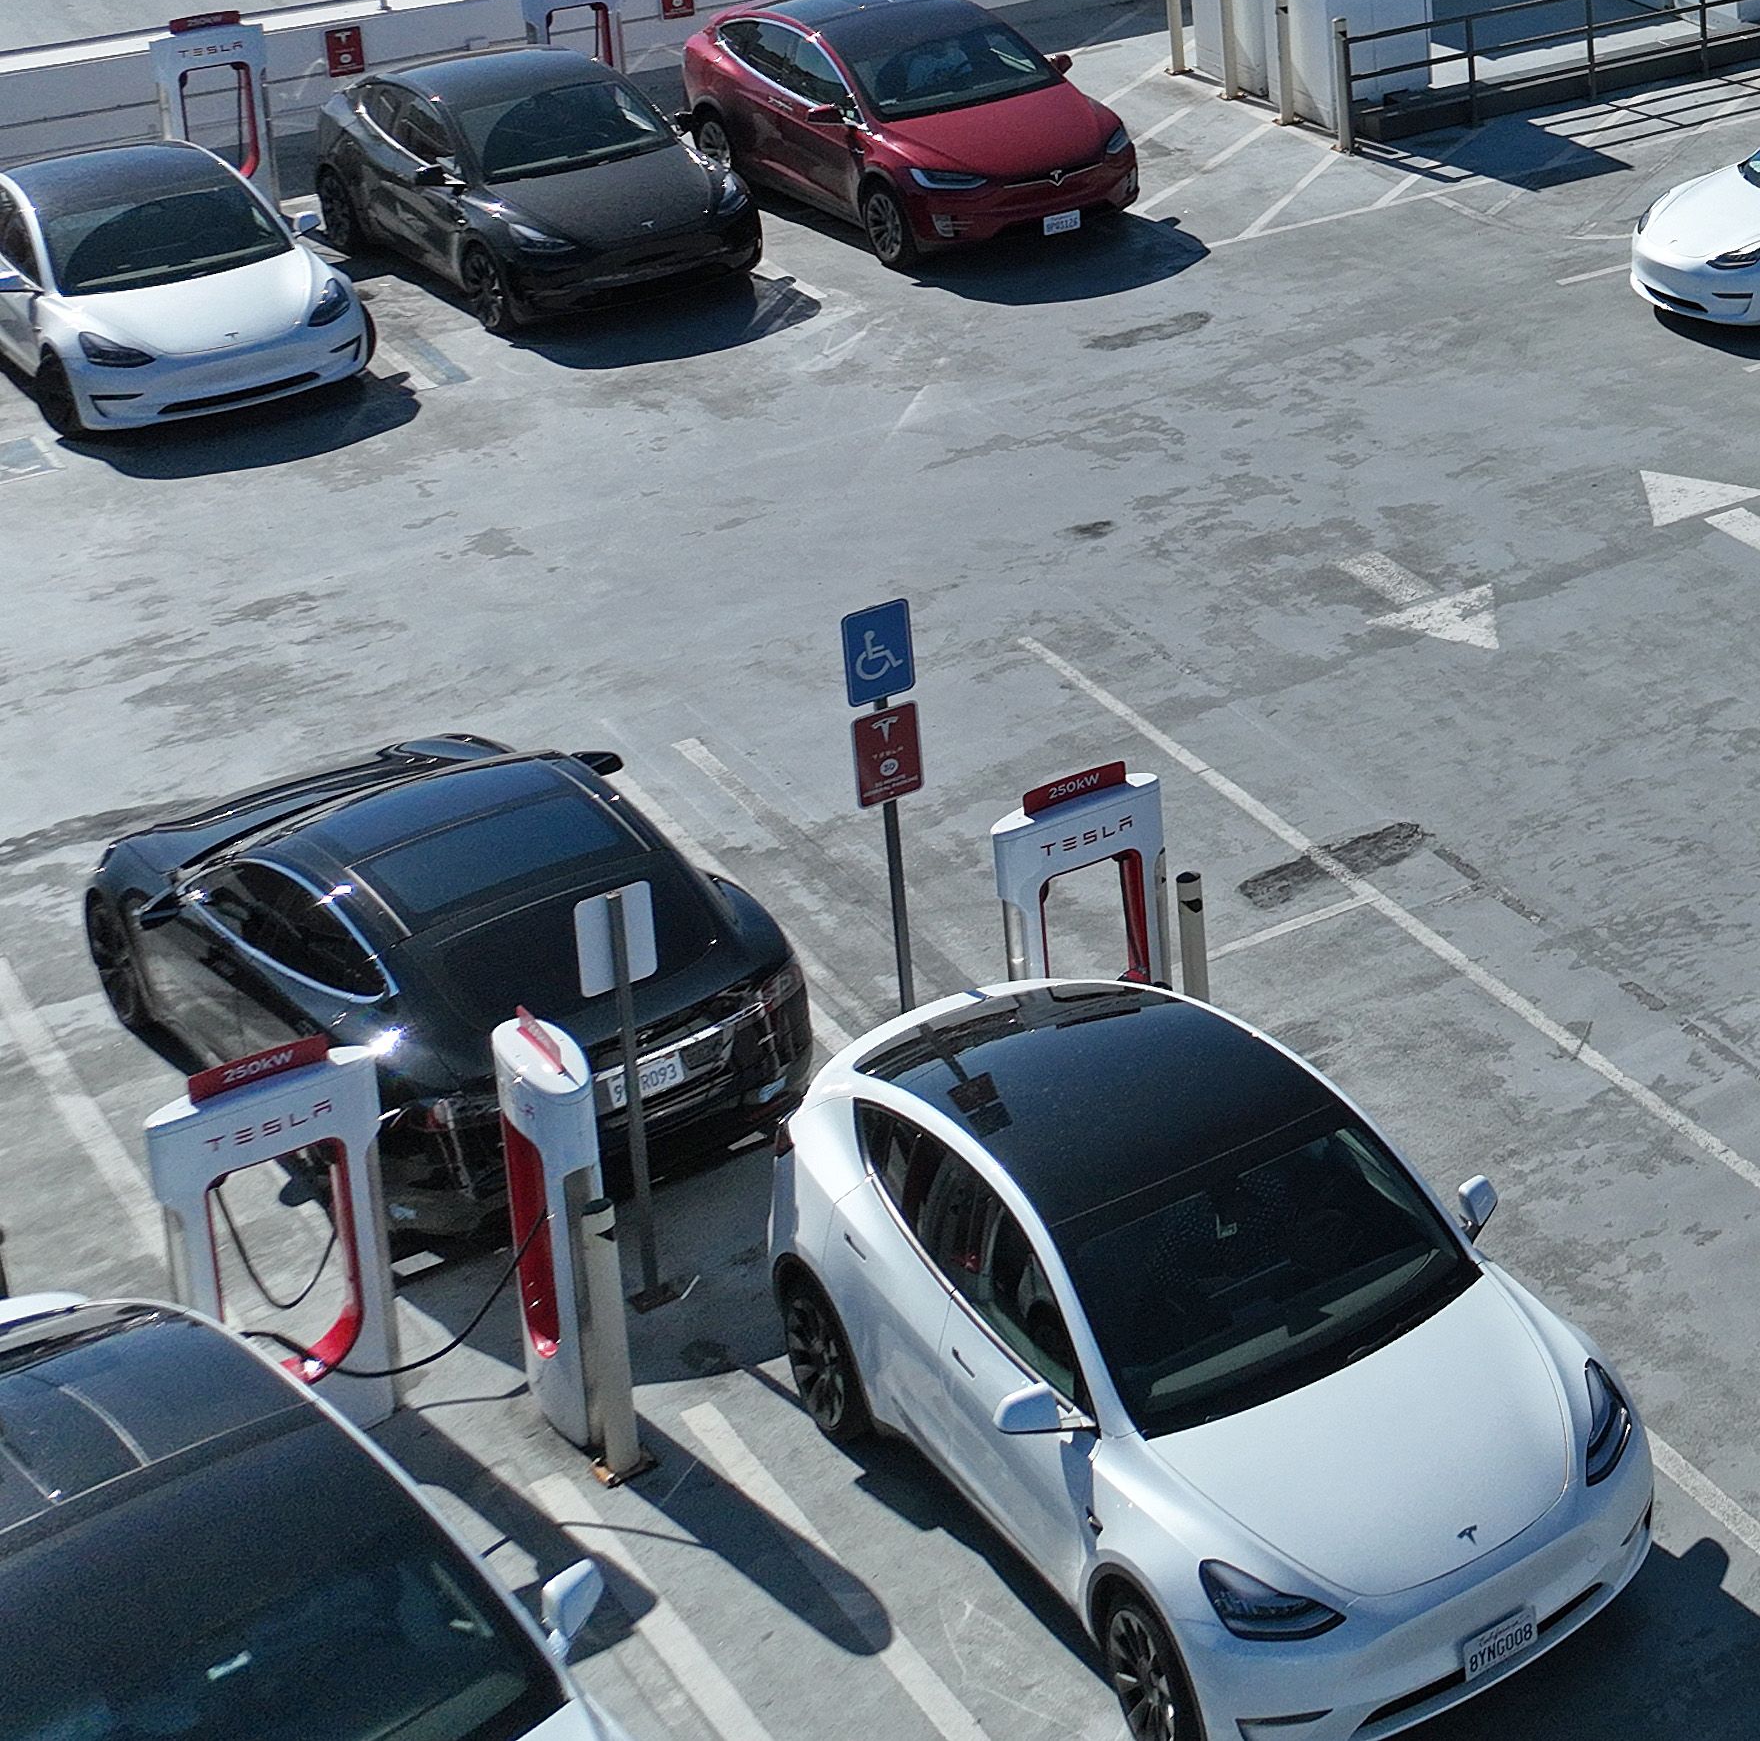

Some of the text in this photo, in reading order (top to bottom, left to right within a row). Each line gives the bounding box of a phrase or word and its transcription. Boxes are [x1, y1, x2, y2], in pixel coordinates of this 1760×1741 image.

[177, 41, 244, 58] TESLA
[882, 761, 897, 773] 30
[1048, 772, 1100, 799] 250kW
[1040, 815, 1133, 857] TESLA
[223, 1049, 295, 1085] 250kW
[612, 1062, 679, 1103] 9R093
[203, 1098, 333, 1153] TESLA
[1469, 1622, 1534, 1673] 8YNG008
